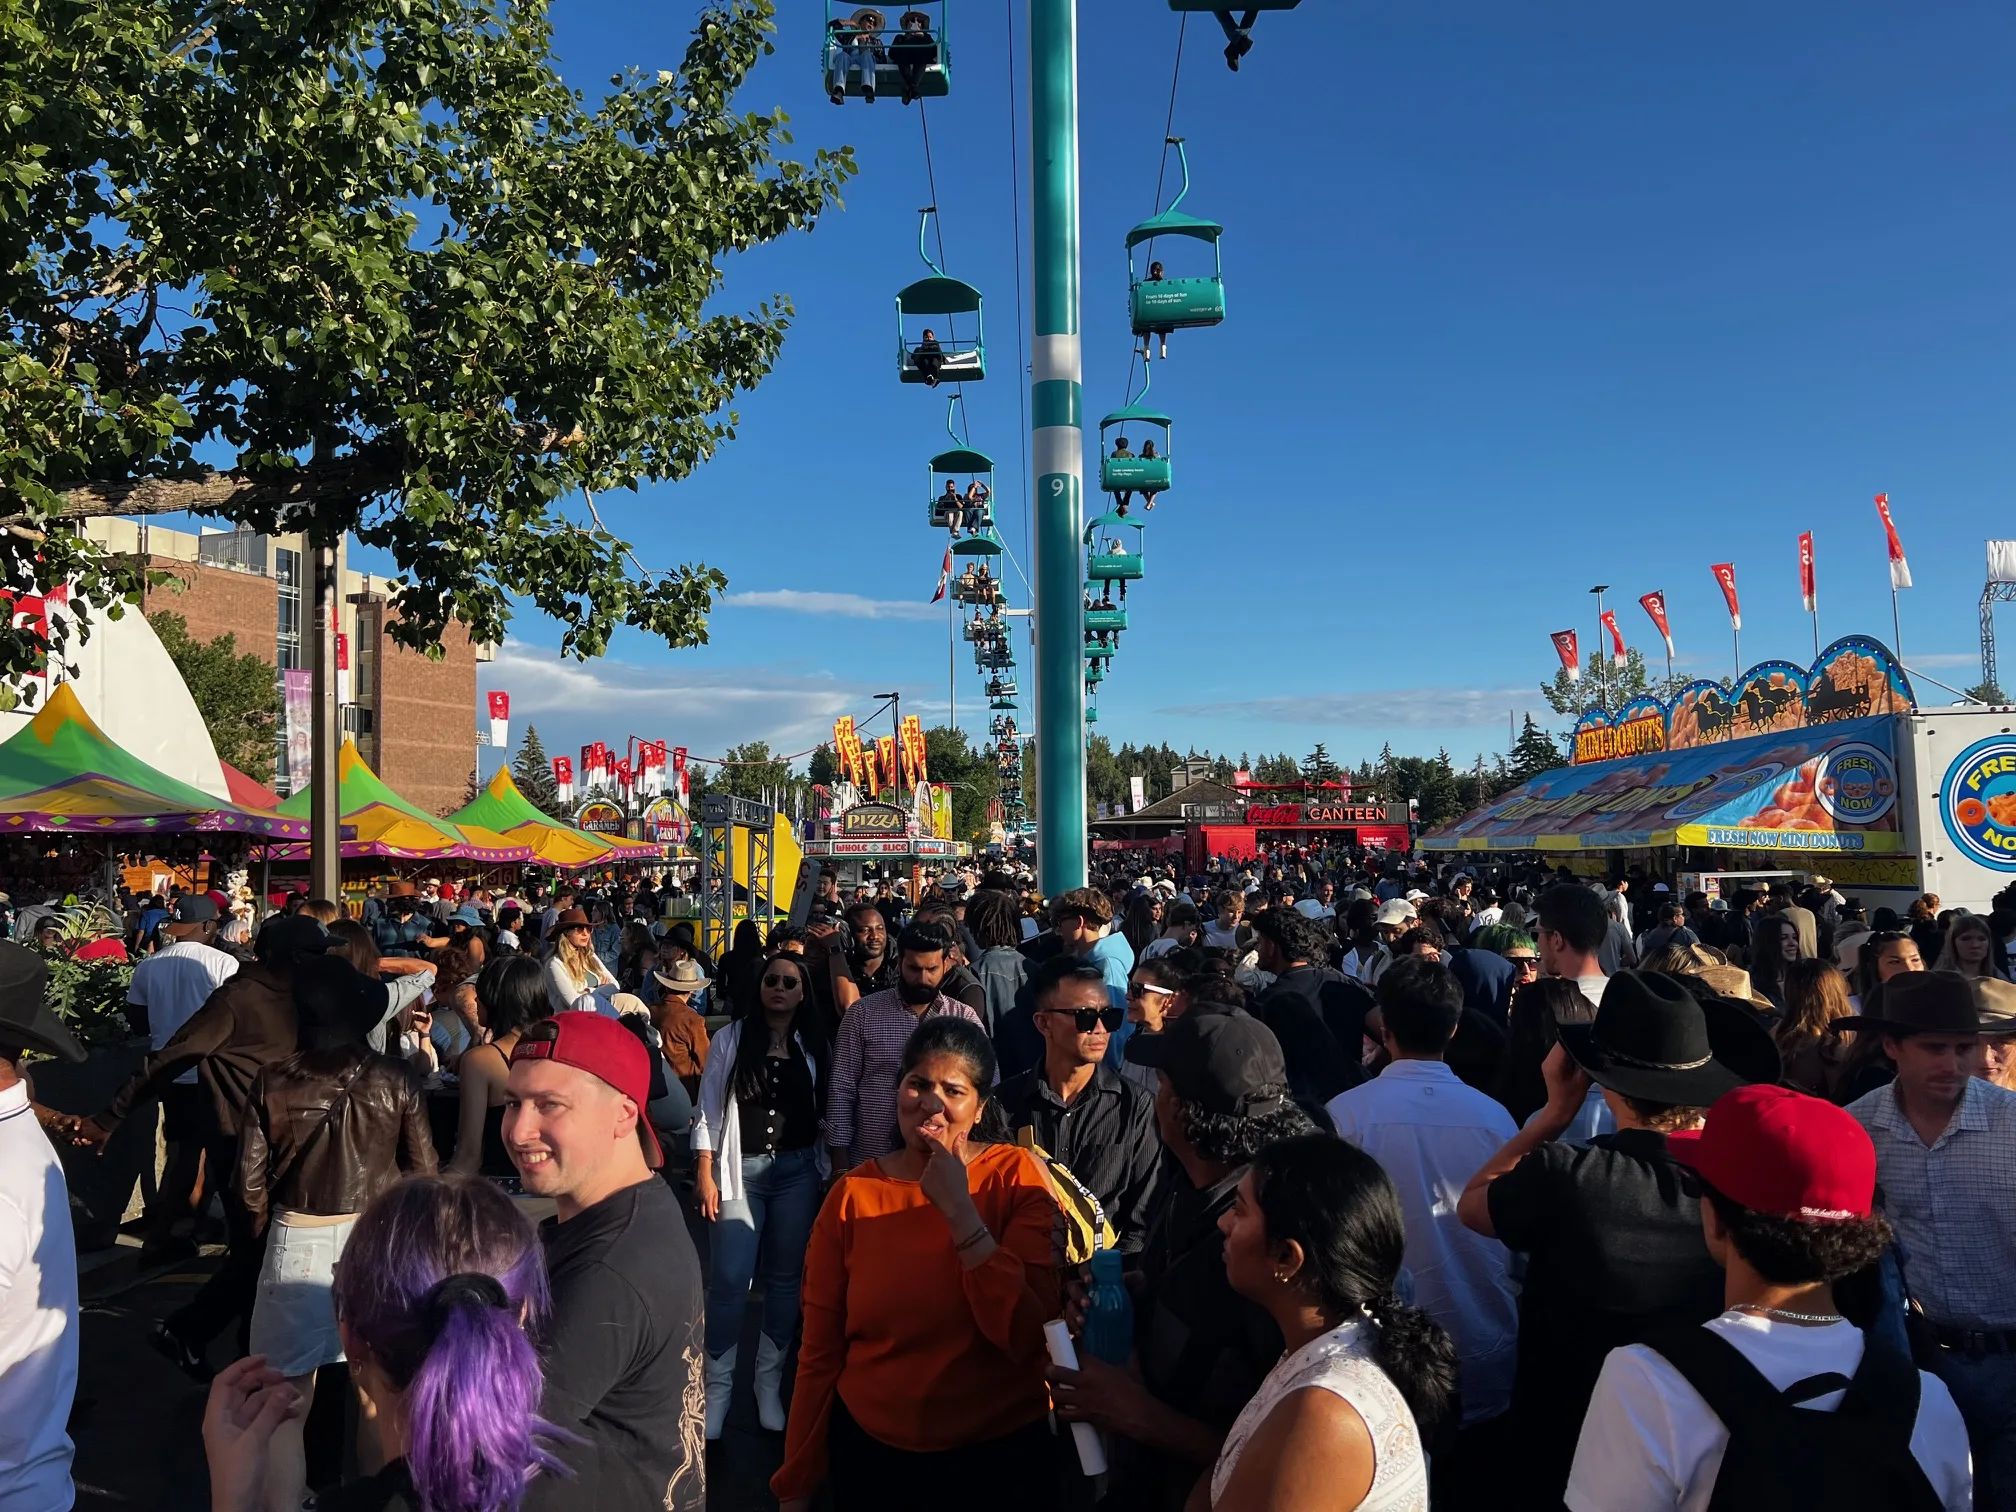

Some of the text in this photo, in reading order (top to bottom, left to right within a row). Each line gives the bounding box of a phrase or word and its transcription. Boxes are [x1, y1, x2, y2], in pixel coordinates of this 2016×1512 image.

[1051, 478, 1064, 496] 9
[1576, 715, 1664, 764] MINI-DONUTS
[1836, 757, 1876, 775] FRESH
[1840, 796, 1874, 810] NOW
[1310, 807, 1386, 820] CANTEEN
[583, 821, 620, 830] CARAMEL
[848, 815, 900, 829] PIZZA
[1707, 828, 1864, 850] FRESH NOW MINI DONUTS
[836, 844, 868, 852] WHOLE
